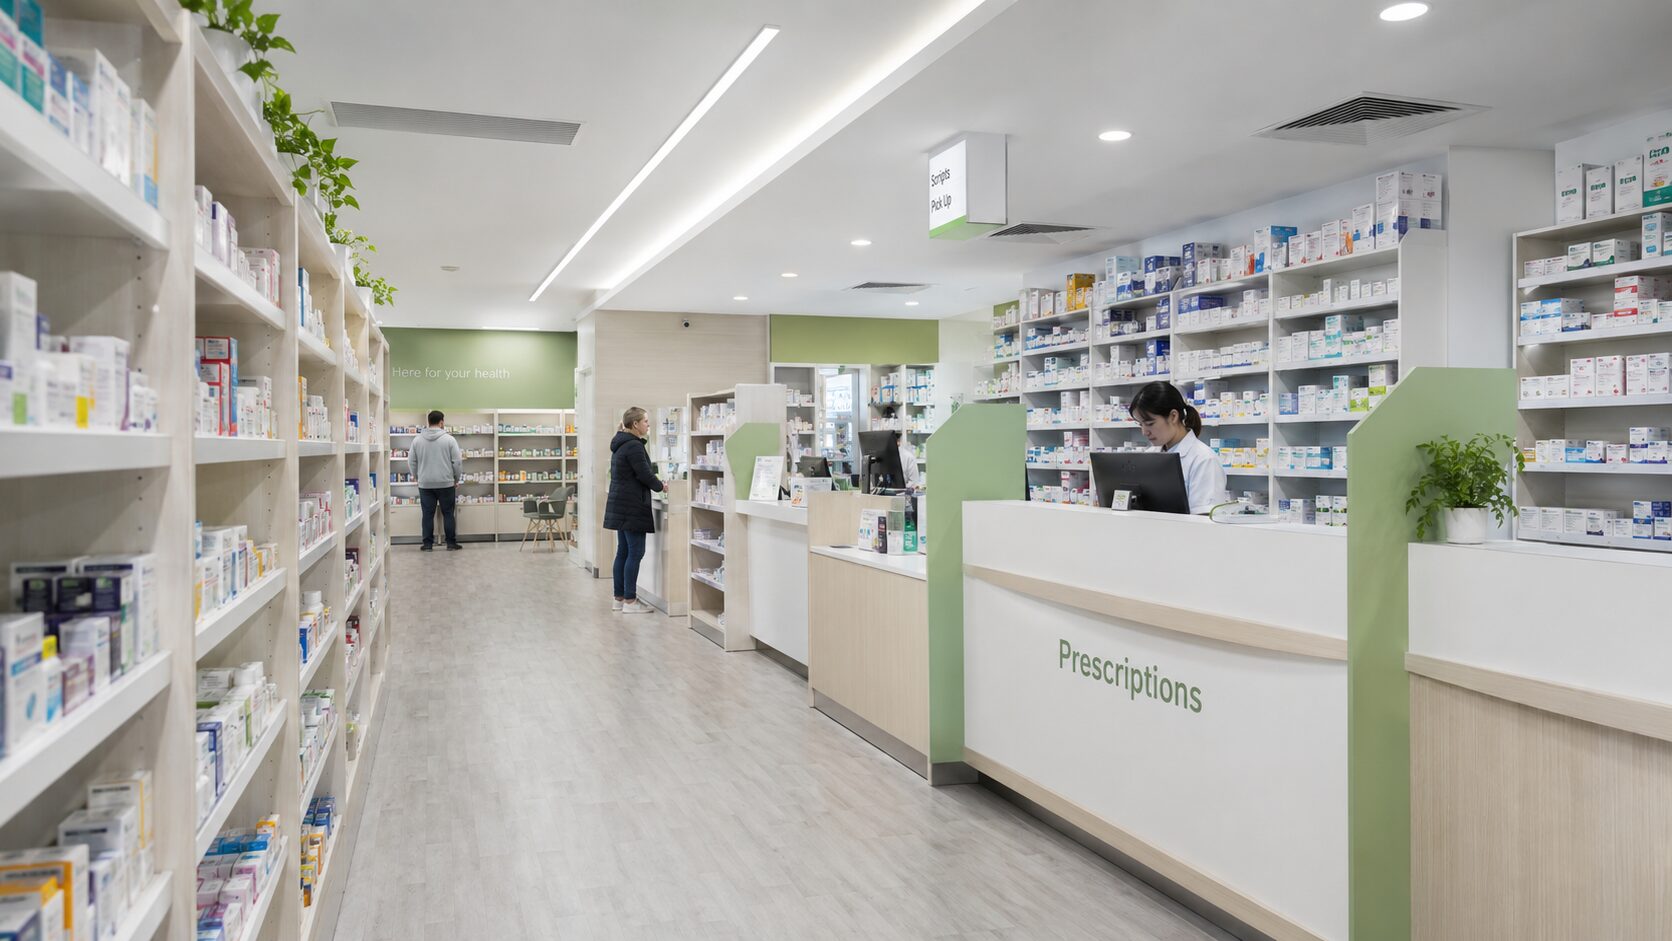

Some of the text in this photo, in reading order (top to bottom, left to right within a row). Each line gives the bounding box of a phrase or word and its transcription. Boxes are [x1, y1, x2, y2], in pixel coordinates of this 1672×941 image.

[931, 168, 950, 187] Scripts
[931, 194, 952, 213] Pick Up
[392, 366, 511, 380] Here for your health
[1059, 638, 1203, 714] Prescriptions
